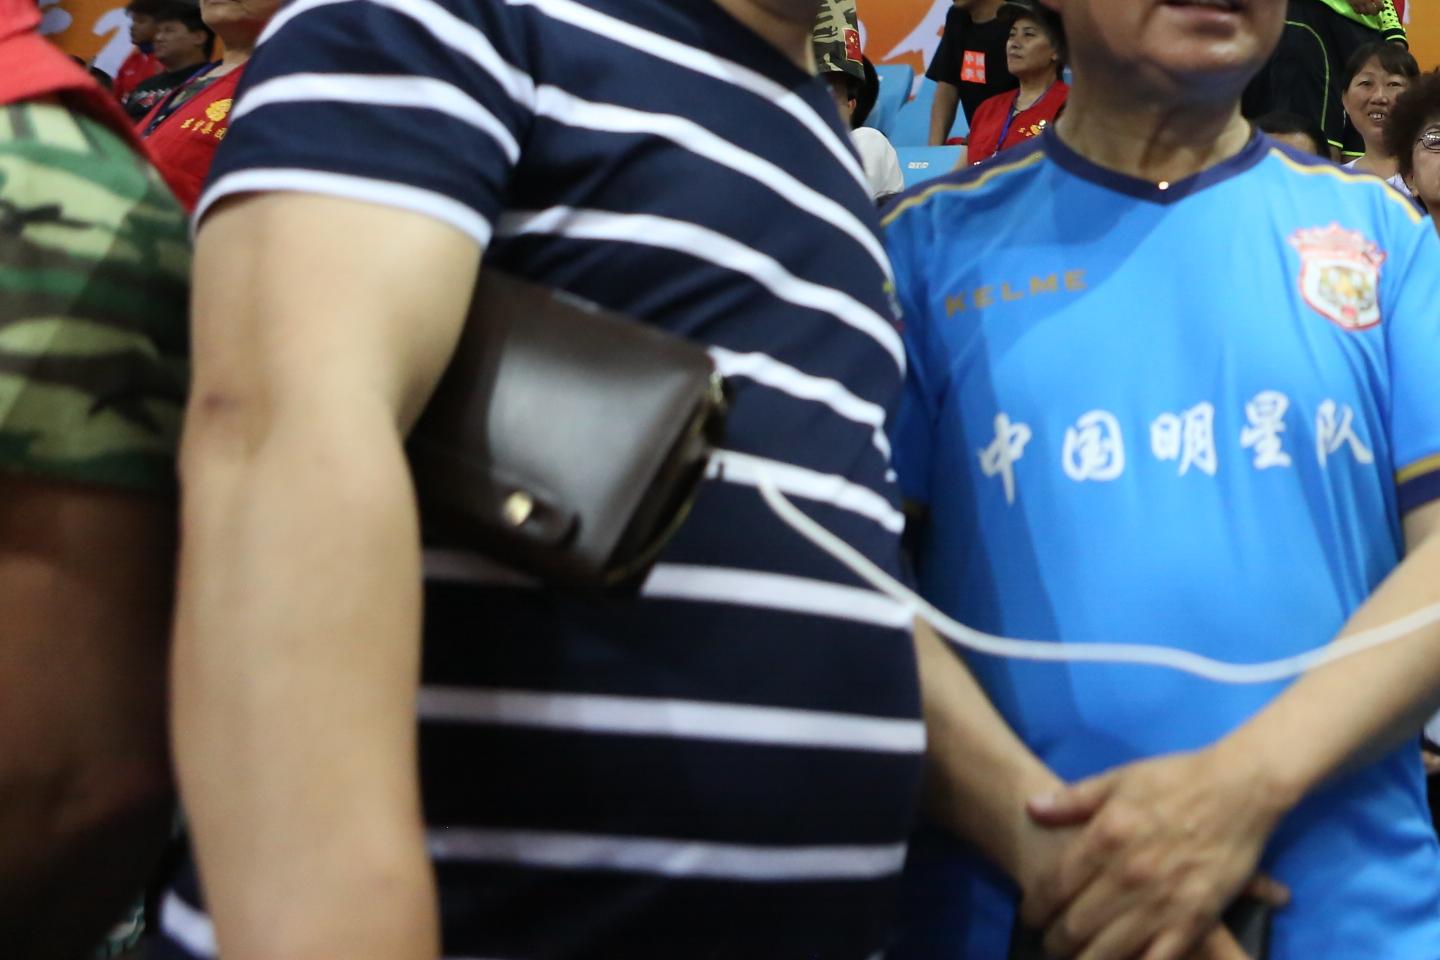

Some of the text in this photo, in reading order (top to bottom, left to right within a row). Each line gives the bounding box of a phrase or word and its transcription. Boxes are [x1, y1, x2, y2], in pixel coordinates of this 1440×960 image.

[945, 269, 1087, 320] KELME
[977, 389, 1374, 506] 中国明星队
